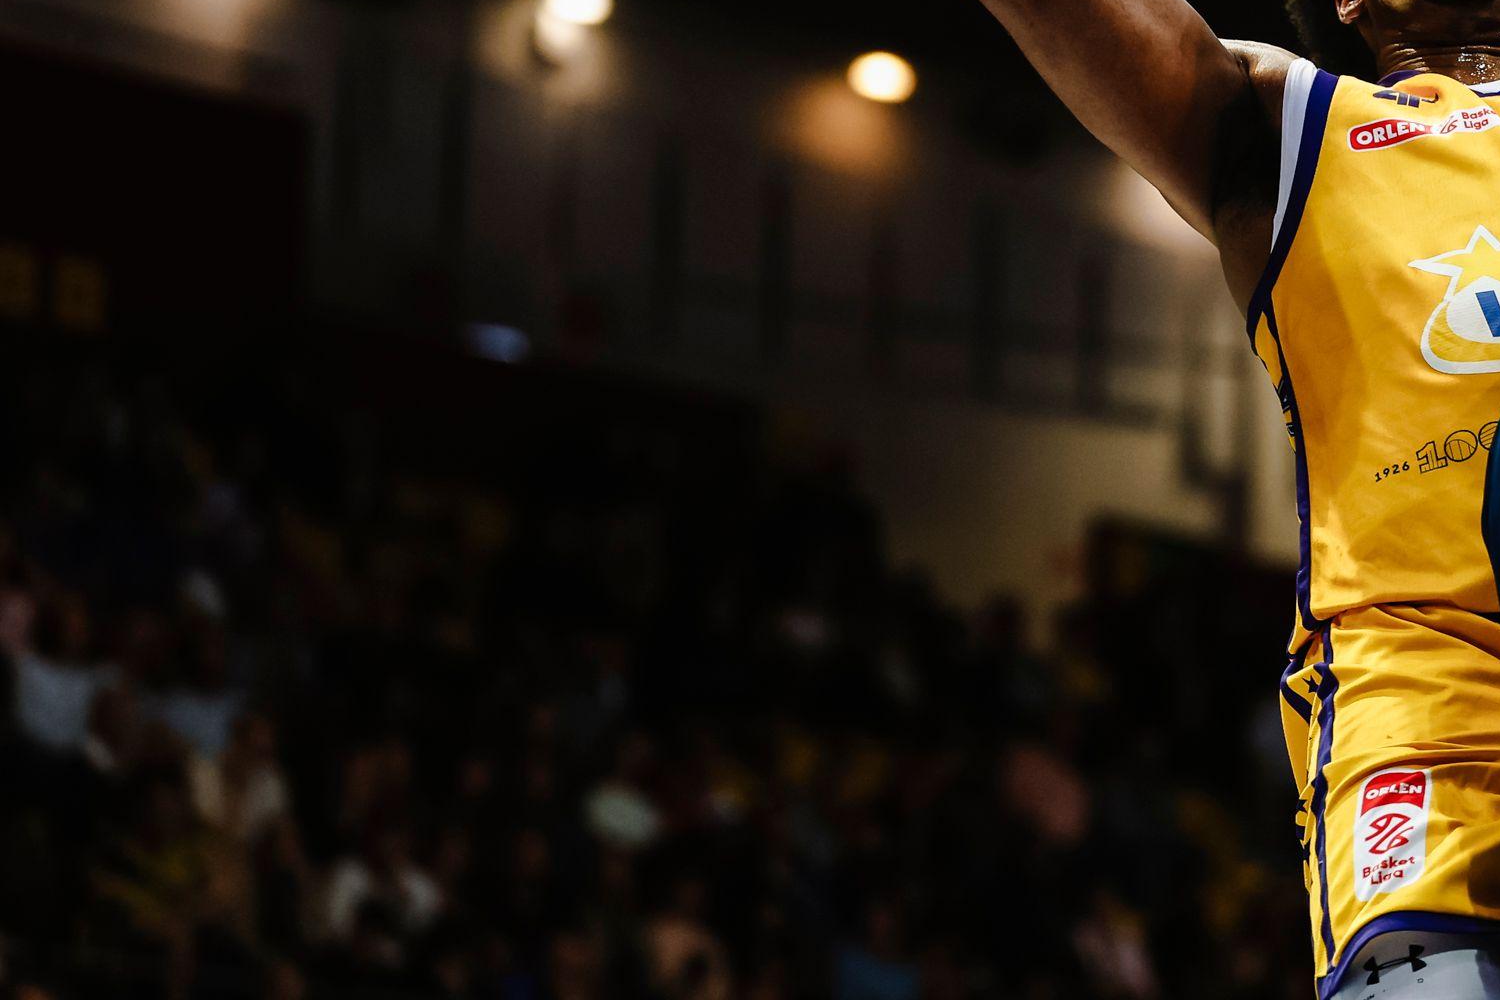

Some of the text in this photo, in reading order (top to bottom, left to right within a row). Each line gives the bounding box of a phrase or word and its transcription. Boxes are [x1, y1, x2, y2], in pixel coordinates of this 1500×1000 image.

[1356, 121, 1426, 146] ORLEN
[1464, 118, 1489, 130] Liga
[1374, 461, 1411, 483] 1926
[1364, 782, 1423, 800] ORLEN
